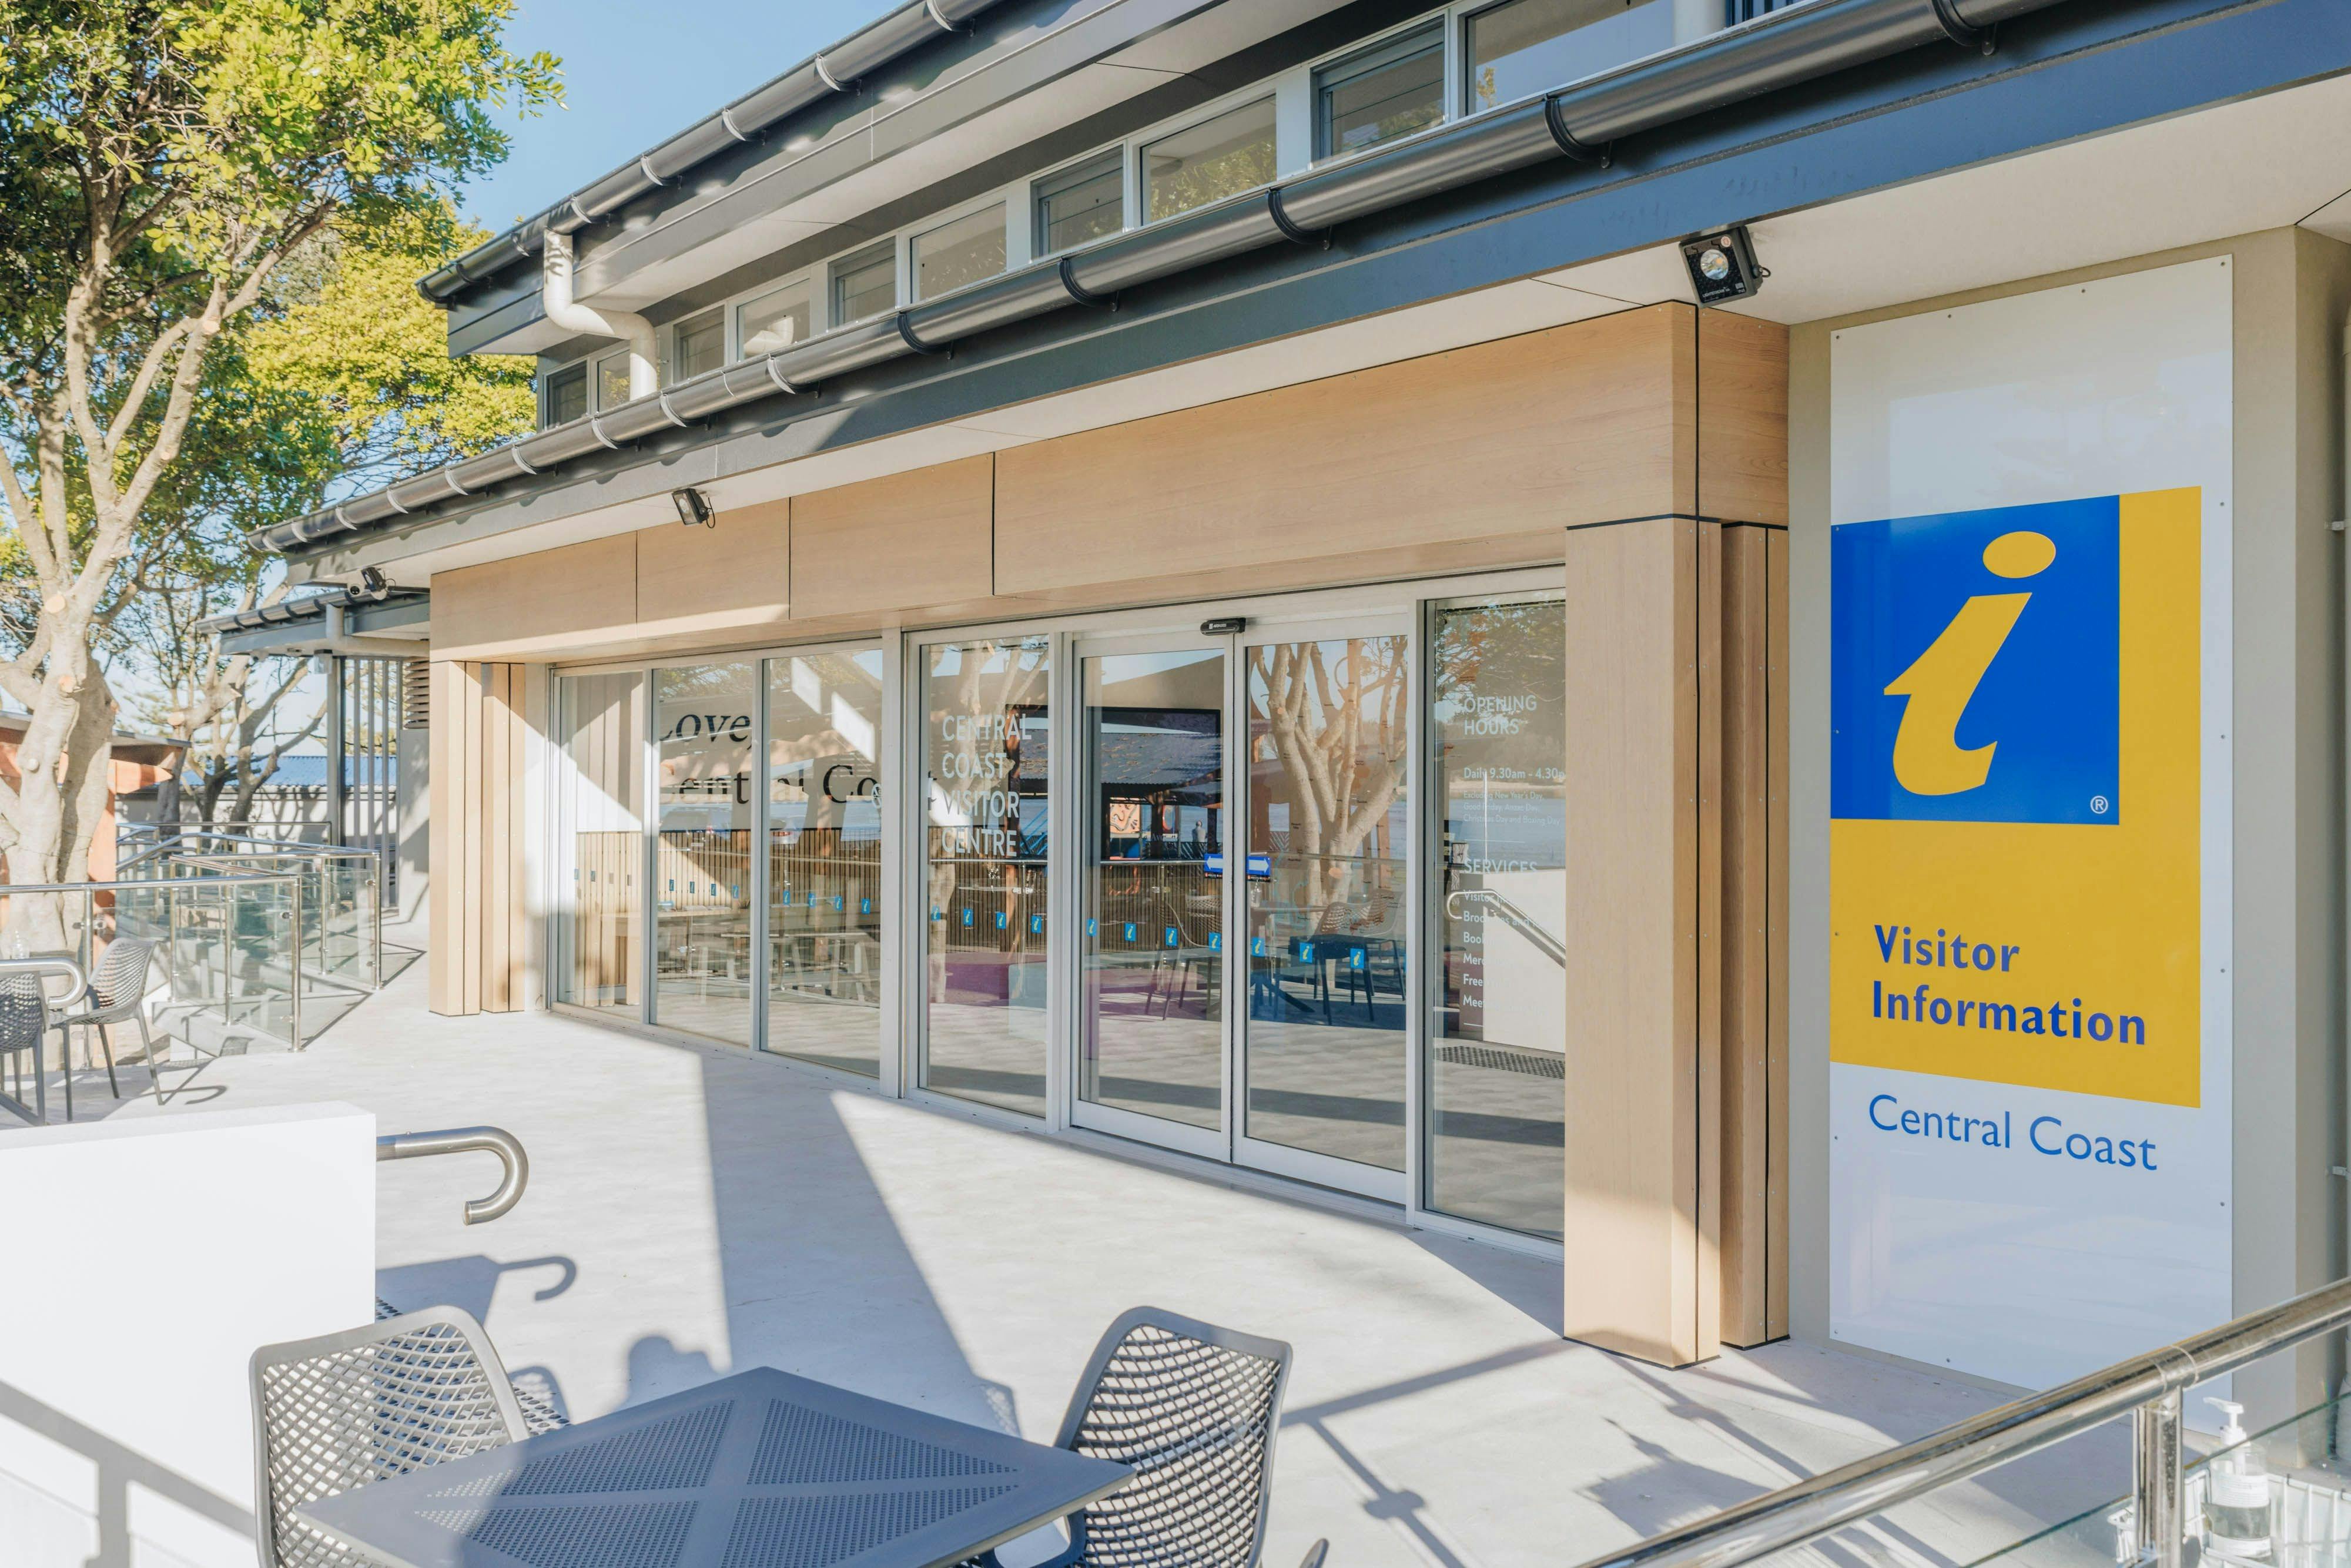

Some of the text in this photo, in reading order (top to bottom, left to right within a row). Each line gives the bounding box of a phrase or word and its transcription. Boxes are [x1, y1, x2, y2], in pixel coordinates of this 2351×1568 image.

[1464, 694, 1538, 713] OPENING
[942, 713, 1032, 742] CENTRAL
[1463, 718, 1520, 735] HOURS
[942, 752, 1007, 779] COAST
[1463, 767, 1487, 781] Daily
[1489, 767, 1526, 779] 9.30am
[1535, 768, 1566, 782] 4.30p
[942, 789, 1020, 818] VISITOR
[1463, 791, 1493, 802] Excludng
[1495, 791, 1509, 799] New
[942, 826, 1017, 857] CENTRE
[1463, 857, 1538, 875] SERVICES
[1874, 924, 2020, 972] Visitor
[1463, 973, 1483, 987] Free
[1873, 980, 2146, 1045] Information
[1868, 1094, 2158, 1171] Central Coast
